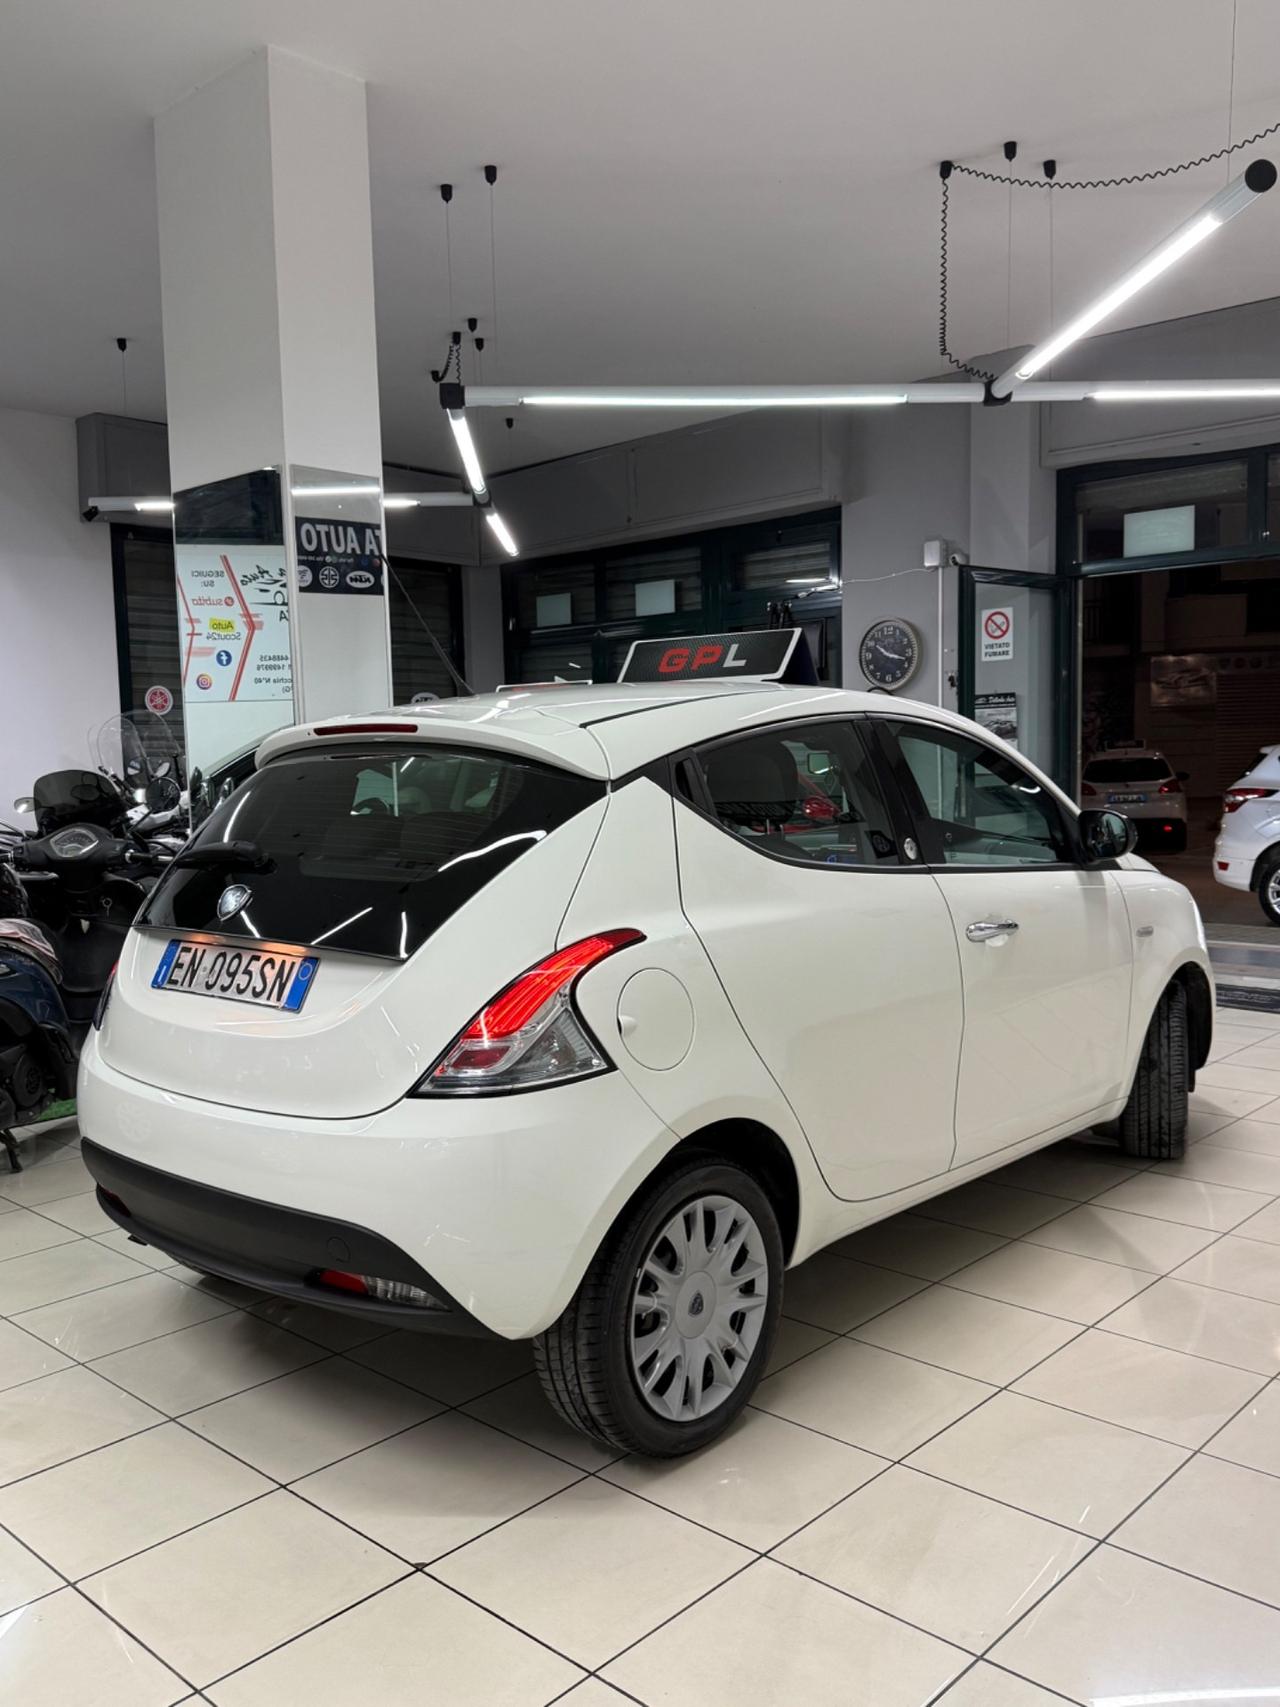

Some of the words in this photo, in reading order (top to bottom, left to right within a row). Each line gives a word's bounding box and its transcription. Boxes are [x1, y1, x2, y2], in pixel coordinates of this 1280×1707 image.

[658, 643, 748, 674] GPL
[984, 642, 1010, 650] VIETATO
[167, 946, 206, 988] EN
[205, 951, 296, 1003] 095SN
